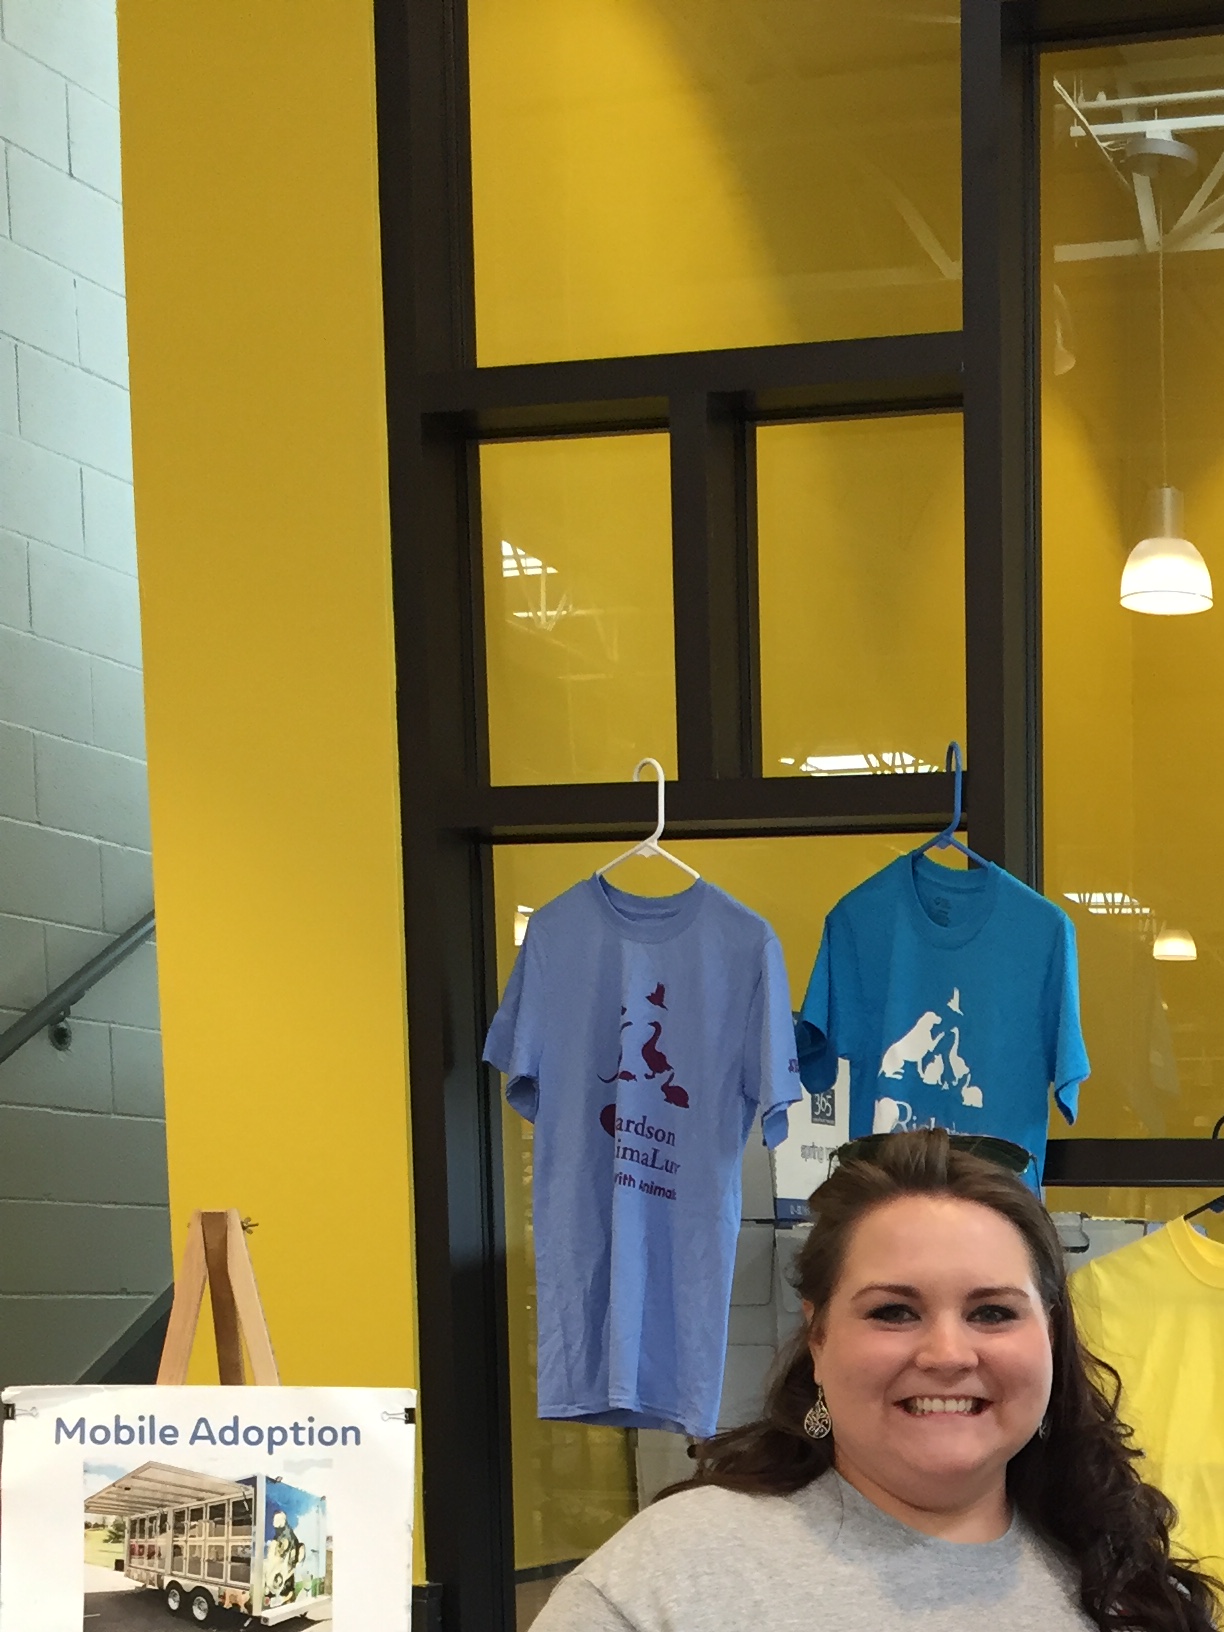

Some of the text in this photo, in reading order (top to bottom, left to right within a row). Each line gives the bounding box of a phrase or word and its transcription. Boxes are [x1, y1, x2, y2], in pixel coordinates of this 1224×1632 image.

[814, 1093, 832, 1117] 365
[616, 1115, 676, 1147] ardson
[55, 1414, 361, 1456] Mobile Adoption
